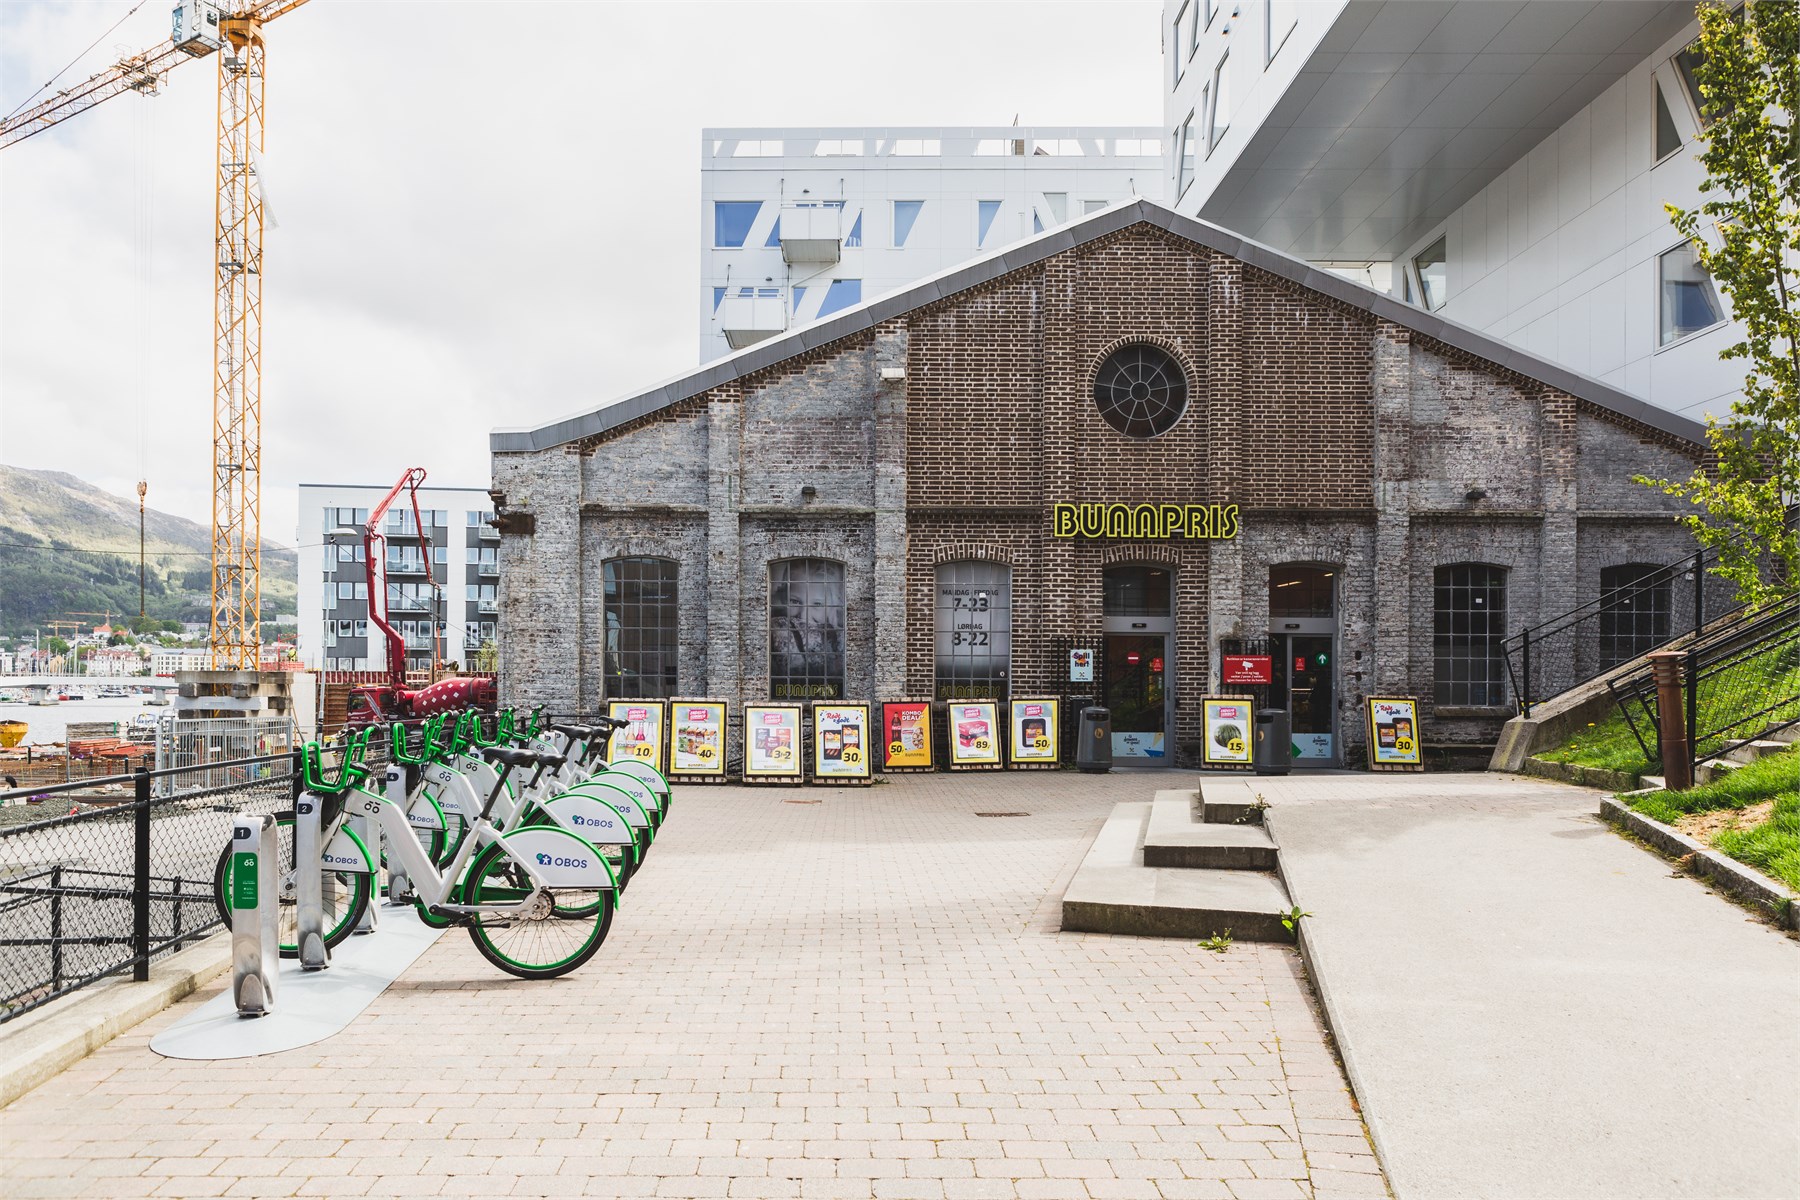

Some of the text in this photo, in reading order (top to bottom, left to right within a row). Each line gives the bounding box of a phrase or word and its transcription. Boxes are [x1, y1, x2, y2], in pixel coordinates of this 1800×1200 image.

[1054, 503, 1239, 539] BUNNPRIS
[954, 597, 989, 612] 7-23
[301, 805, 308, 813] 2
[416, 816, 435, 824] OBOS
[586, 818, 613, 829] OBOS
[239, 829, 245, 837] 1
[335, 856, 358, 865] OBOS
[554, 857, 588, 869] OBOS
